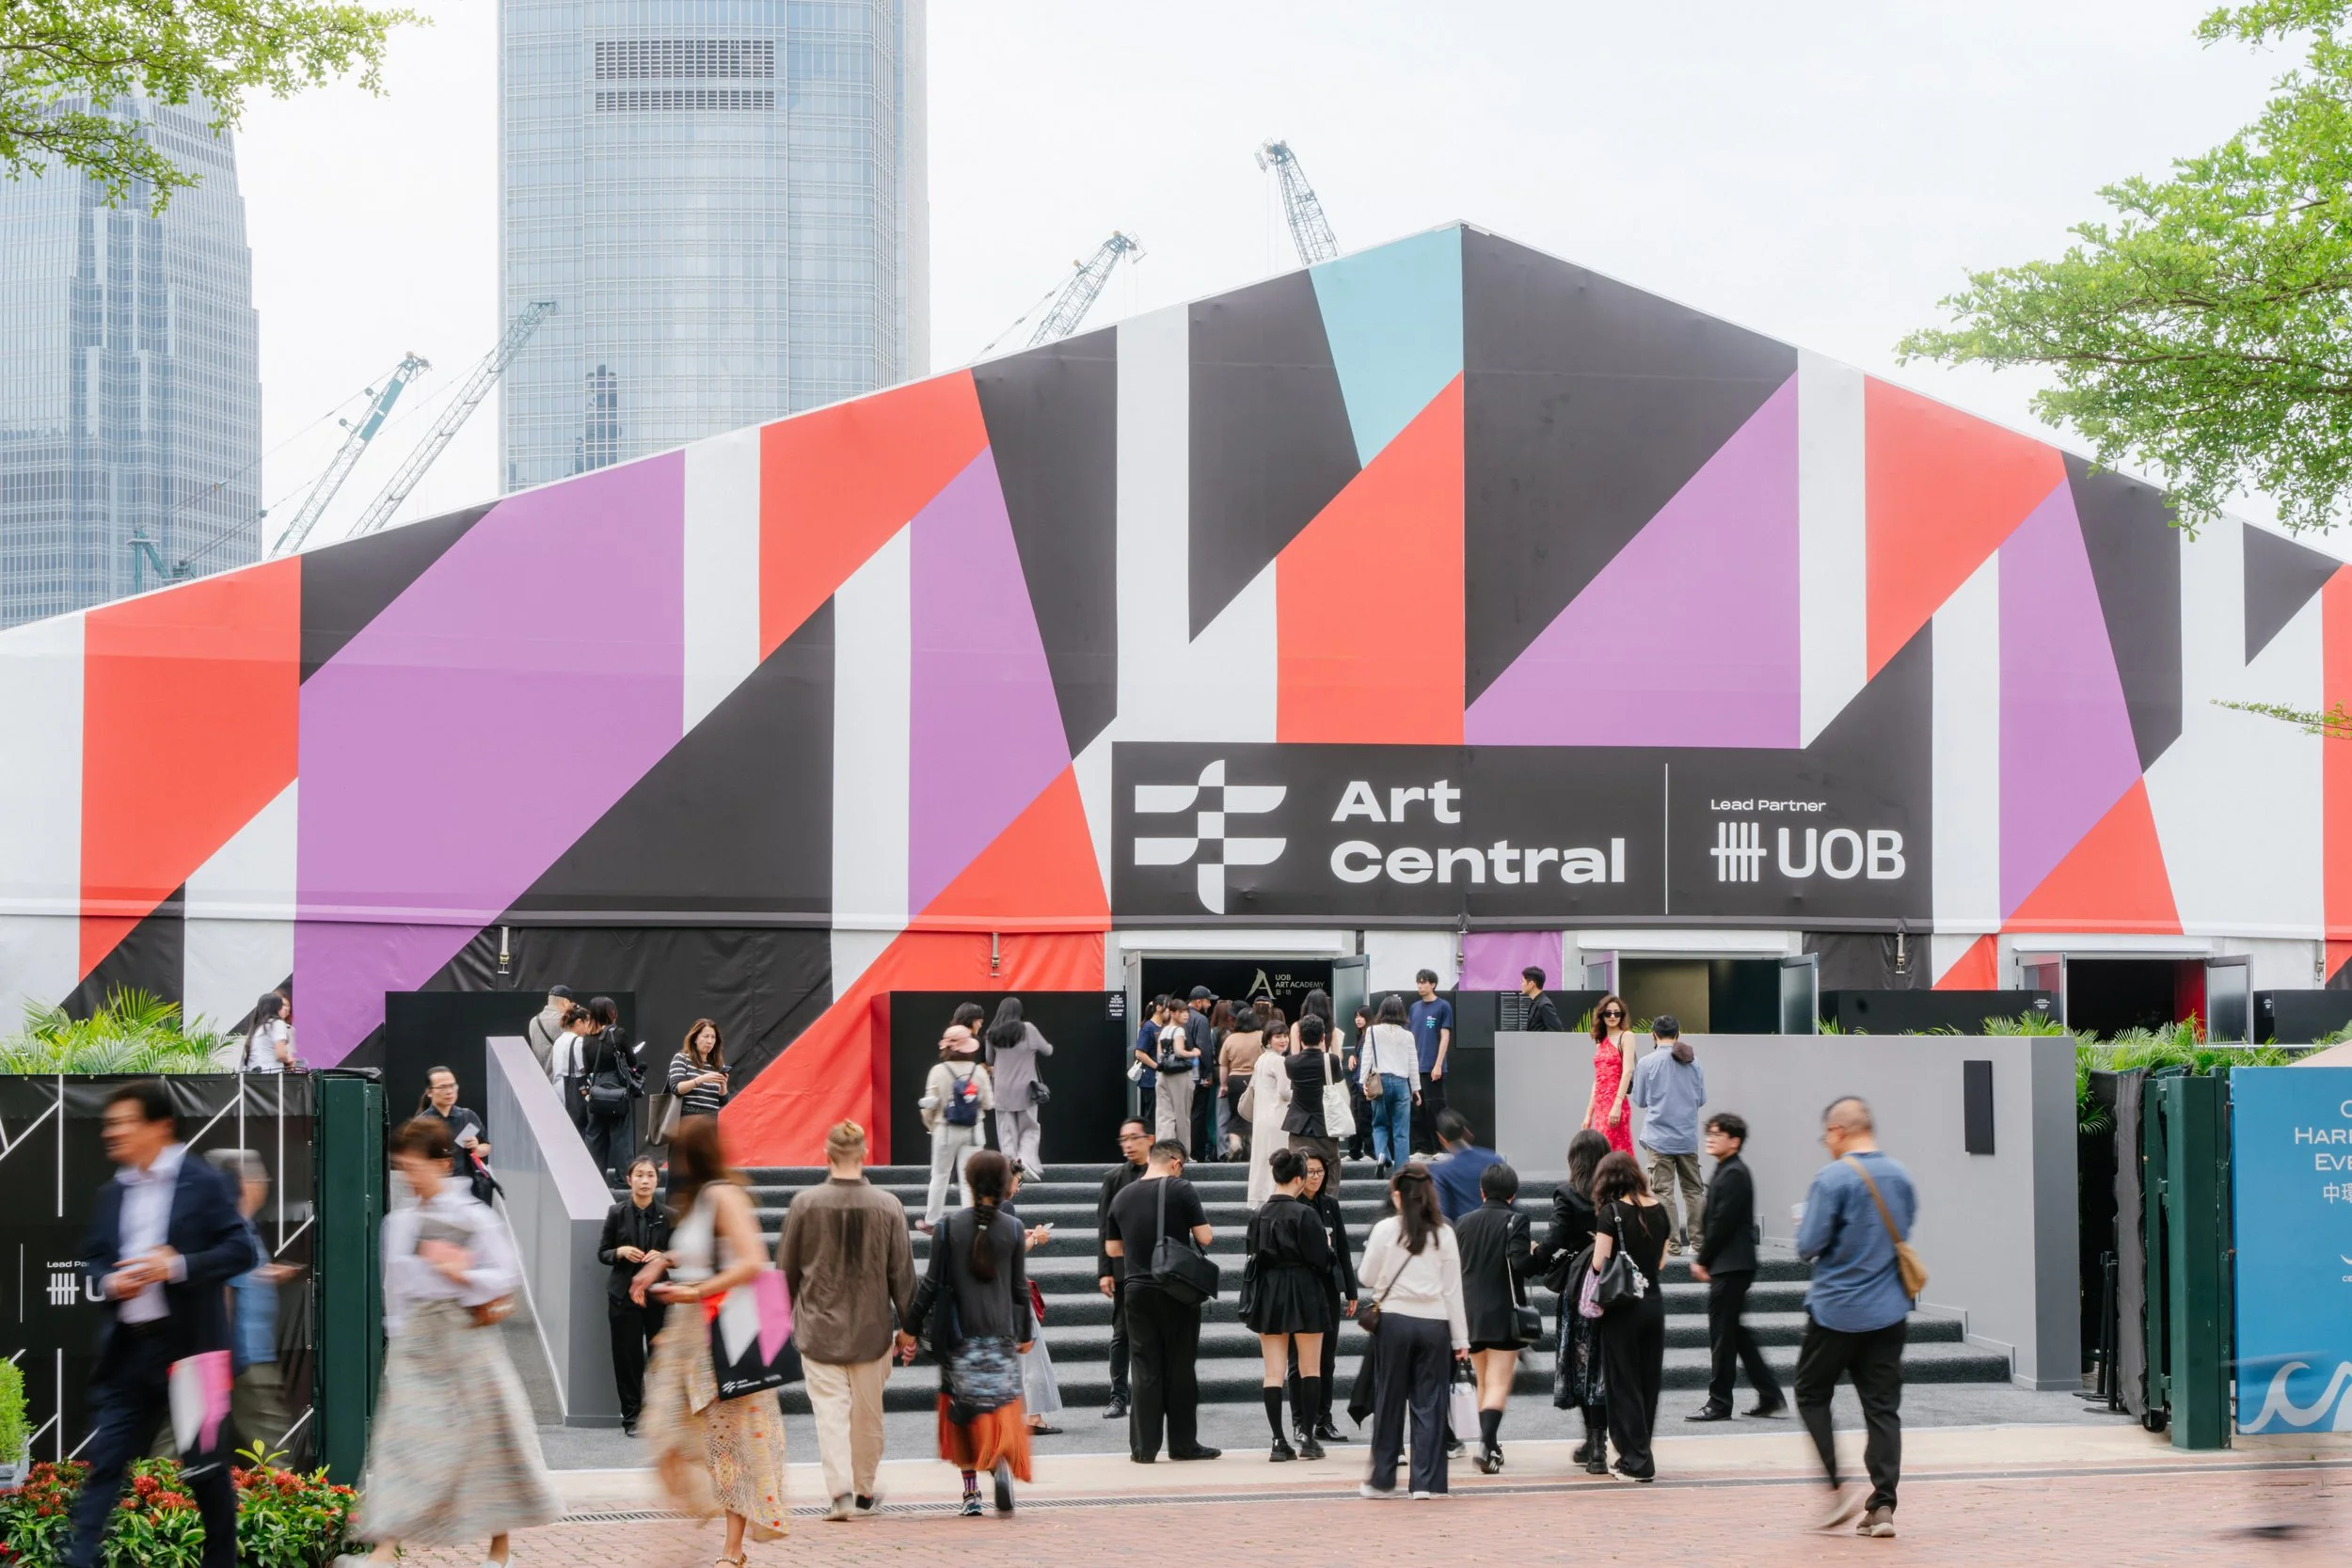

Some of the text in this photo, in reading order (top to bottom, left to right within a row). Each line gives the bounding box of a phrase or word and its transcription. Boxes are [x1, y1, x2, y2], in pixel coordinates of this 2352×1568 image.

[1331, 779, 1461, 824] Art
[1710, 798, 1827, 813] Lead Partner
[1329, 837, 1626, 884] Central
[1777, 827, 1906, 880] UOB
[2295, 1127, 2352, 1145] HAR
